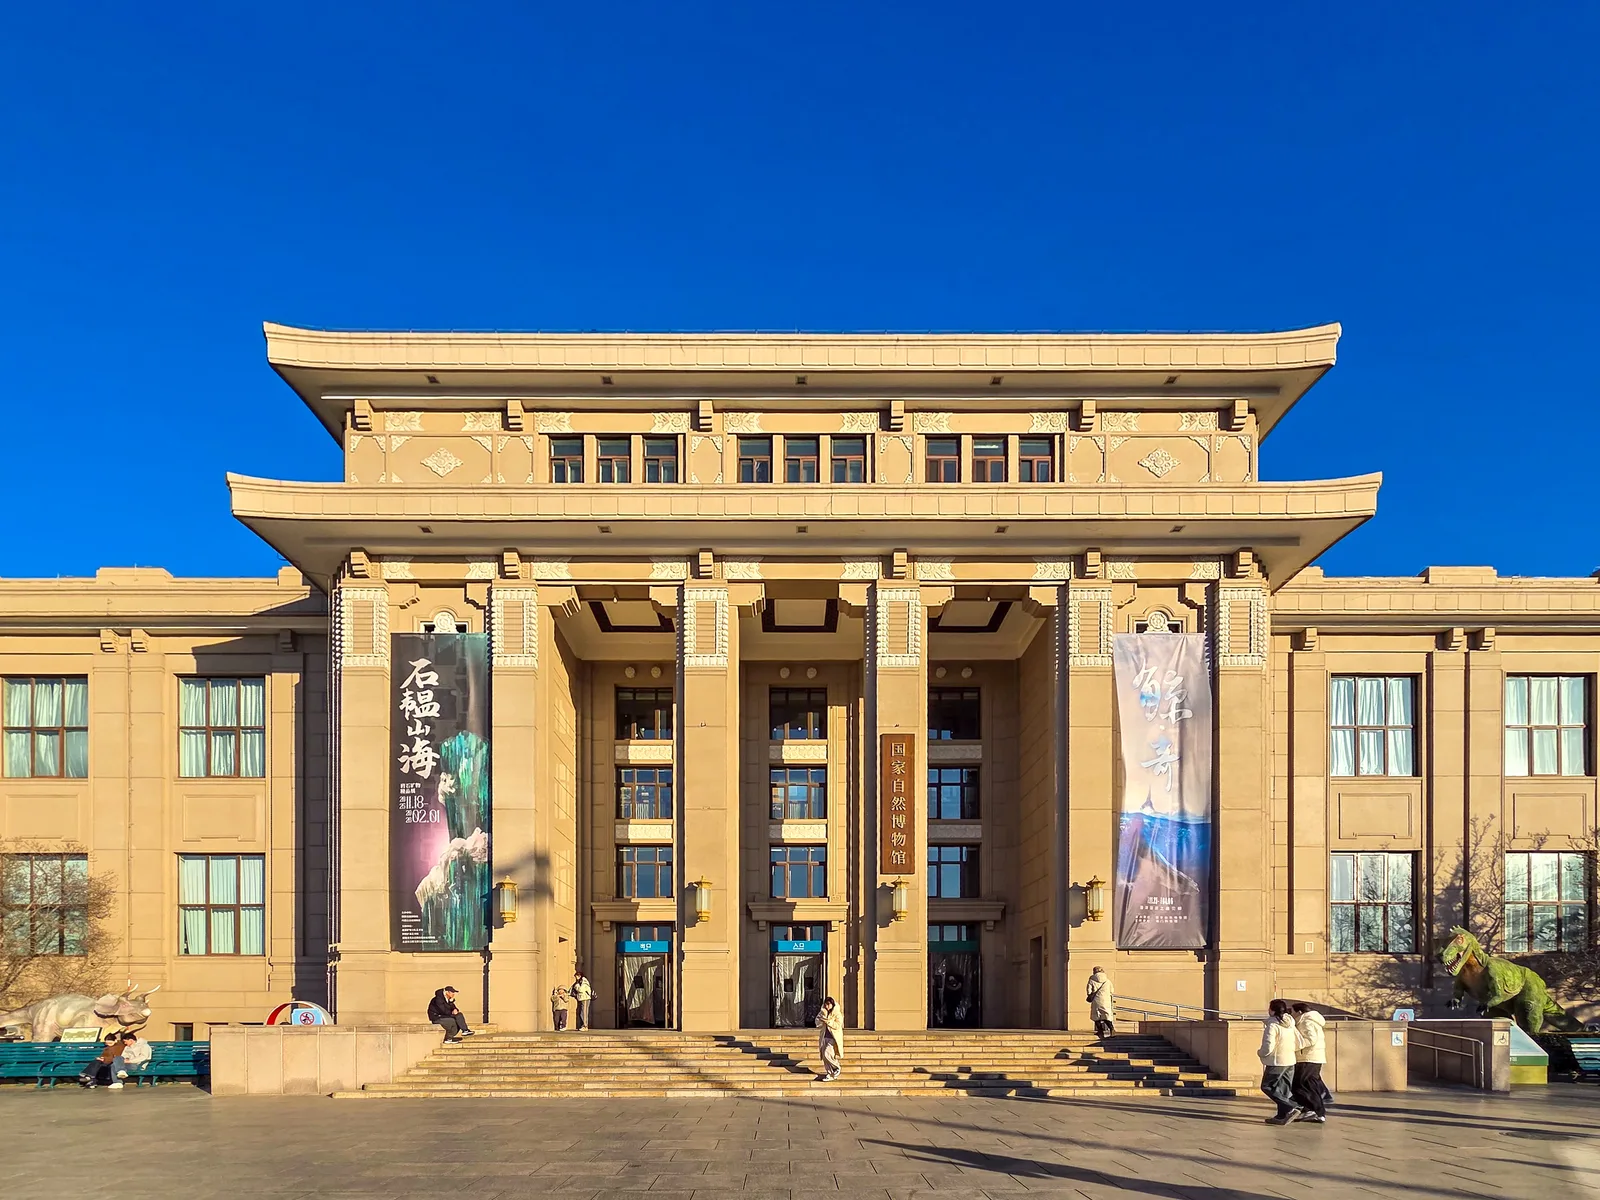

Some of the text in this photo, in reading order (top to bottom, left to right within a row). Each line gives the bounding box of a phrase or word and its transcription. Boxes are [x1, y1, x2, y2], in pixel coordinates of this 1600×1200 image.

[412, 809, 440, 823] 02.01
[891, 742, 906, 865] 国家自然博物馆
